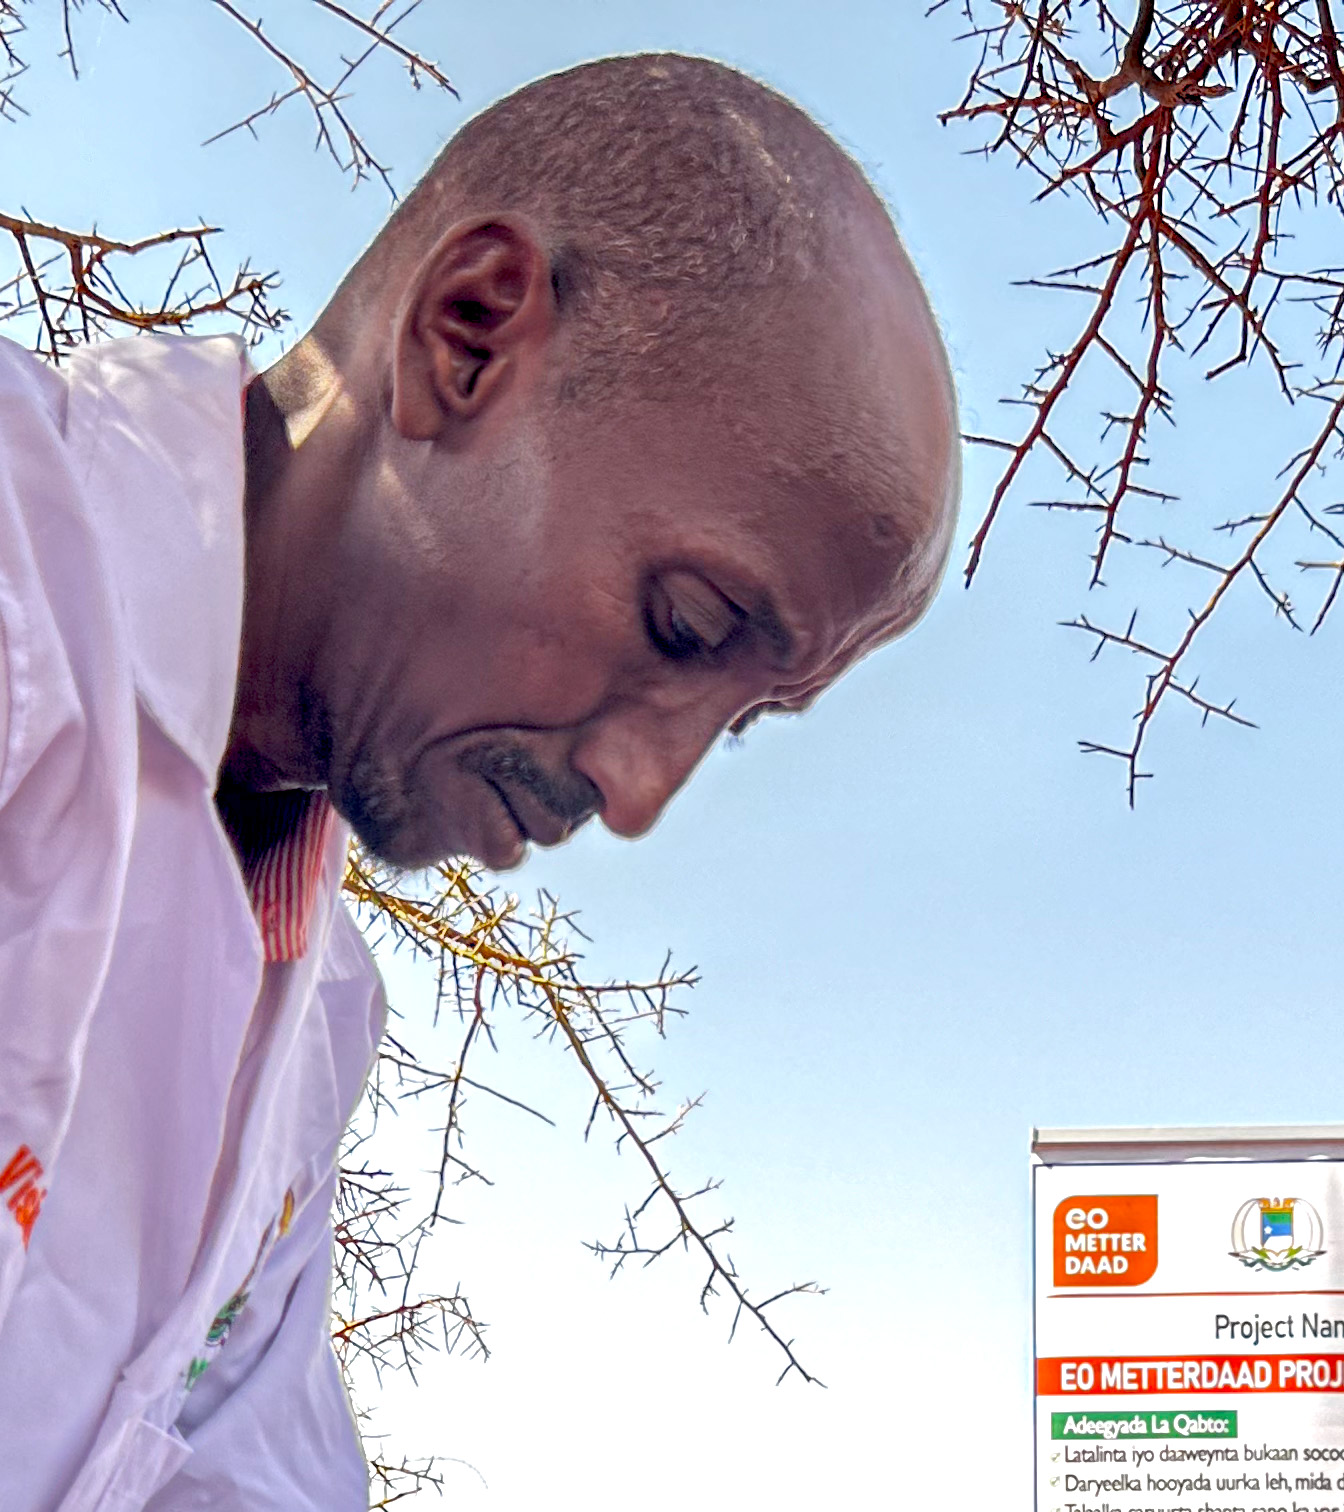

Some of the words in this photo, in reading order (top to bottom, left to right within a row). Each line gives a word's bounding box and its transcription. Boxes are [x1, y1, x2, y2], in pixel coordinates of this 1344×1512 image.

[1066, 1233, 1146, 1252] METTER
[1066, 1256, 1128, 1274] DAAD
[1216, 1314, 1294, 1346] Project
[1062, 1367, 1094, 1390] EO
[1102, 1361, 1271, 1389] METTERDAAD
[1064, 1416, 1147, 1439] Adeegyada
[1152, 1416, 1169, 1433] La
[1065, 1445, 1127, 1462] Latalinta
[1133, 1446, 1154, 1467] iyo
[1160, 1445, 1239, 1466] daaweynta
[1244, 1444, 1298, 1461] bukaan
[1066, 1474, 1141, 1497] Daryeelka
[1147, 1473, 1211, 1496] hooyada
[1217, 1473, 1260, 1490] uurka
[1266, 1473, 1292, 1492] leh,
[1296, 1472, 1332, 1490] mida
